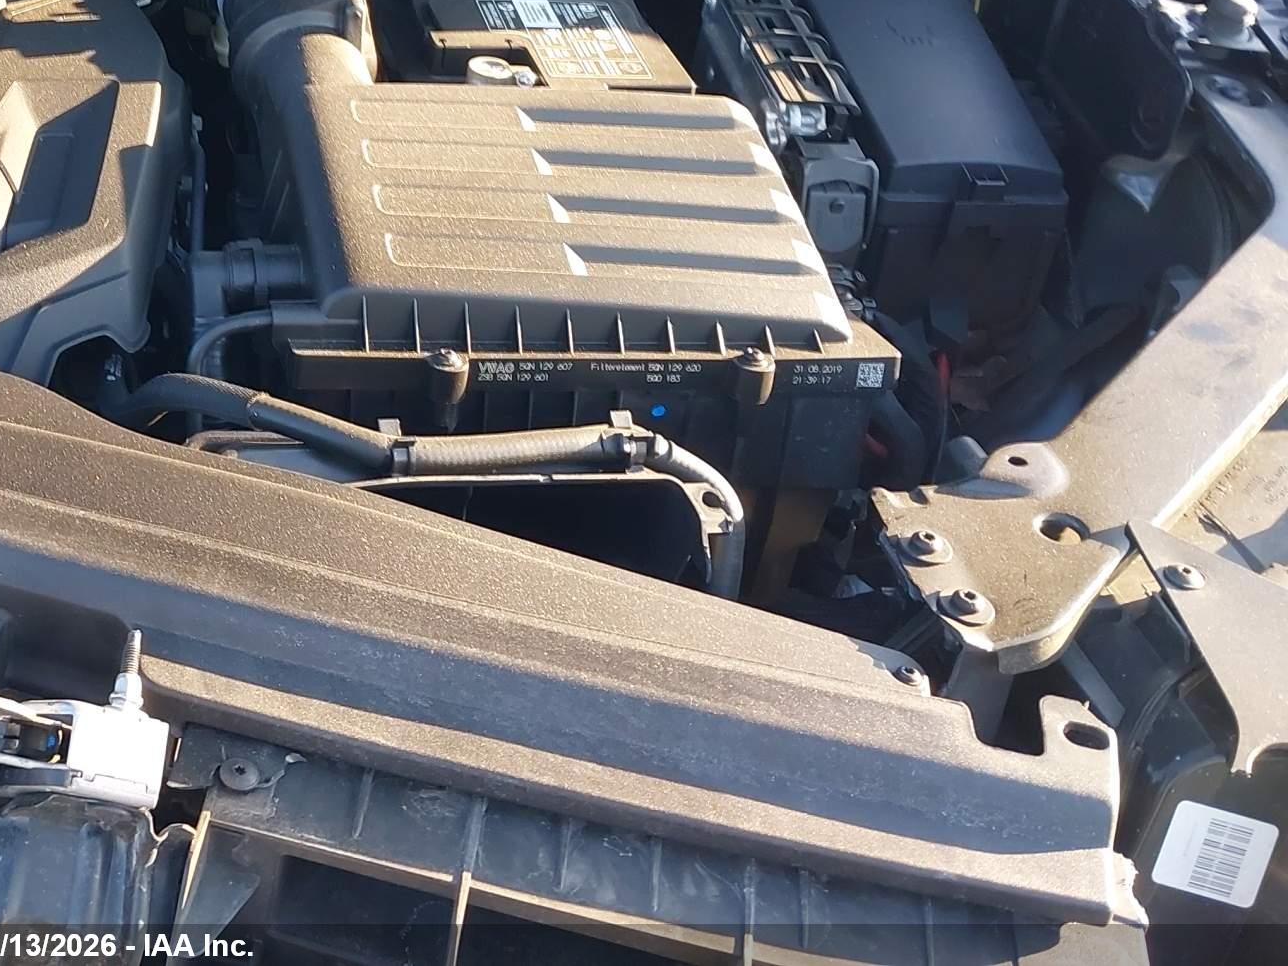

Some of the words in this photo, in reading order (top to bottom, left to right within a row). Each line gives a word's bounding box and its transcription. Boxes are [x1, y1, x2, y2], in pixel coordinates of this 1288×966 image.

[539, 362, 554, 371] 129
[556, 362, 573, 371] 607
[668, 363, 683, 372] 129
[685, 363, 702, 372] 620
[517, 373, 532, 382] 129
[534, 373, 549, 382] 601
